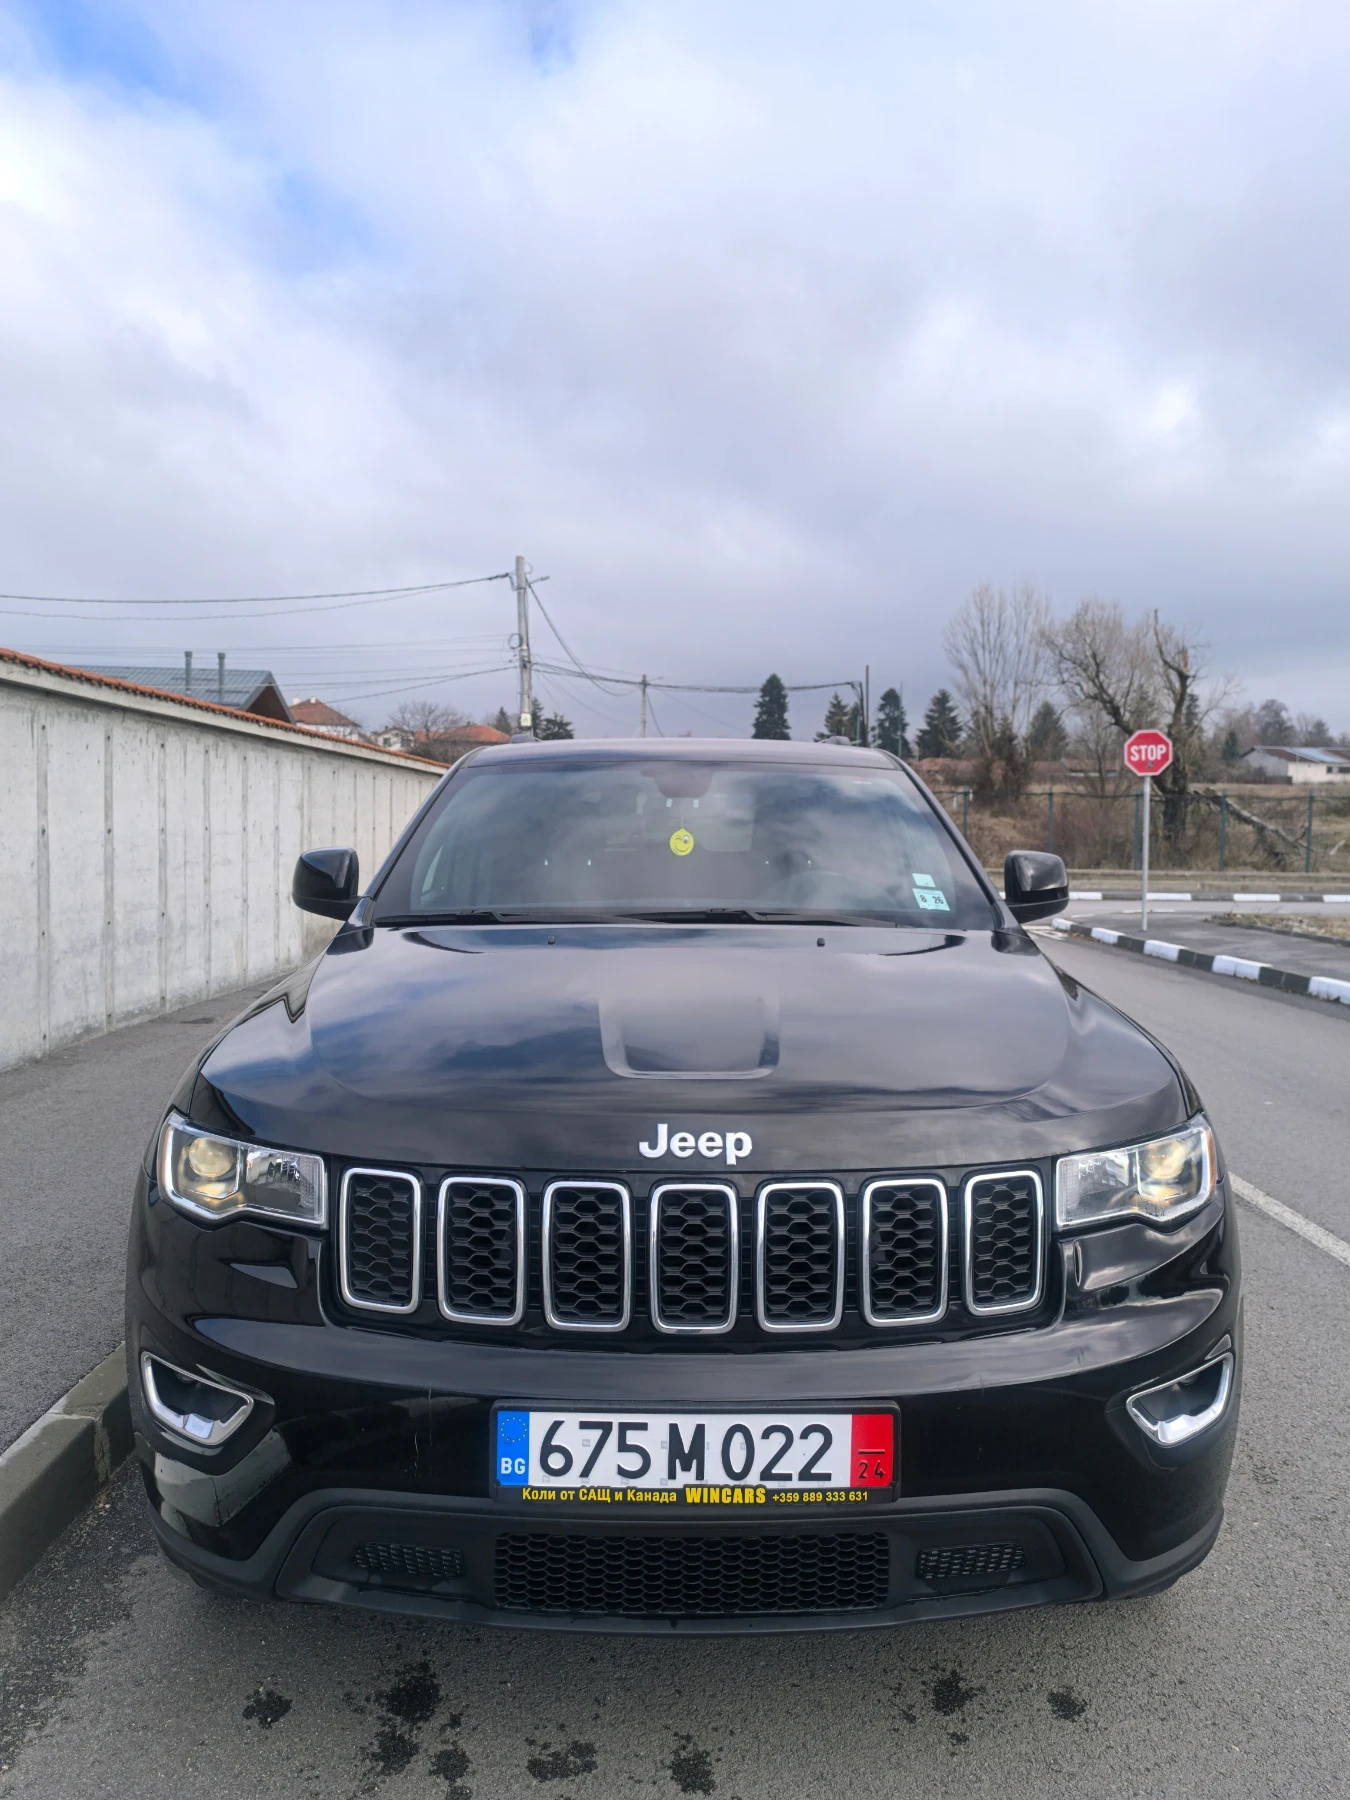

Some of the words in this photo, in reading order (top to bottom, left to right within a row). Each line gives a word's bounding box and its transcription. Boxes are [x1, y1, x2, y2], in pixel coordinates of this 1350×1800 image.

[1130, 744, 1167, 761] STOP
[638, 1123, 753, 1165] Jeep
[539, 1420, 651, 1479] 675
[667, 1423, 706, 1480] M
[721, 1423, 833, 1482] 022
[500, 1457, 526, 1475] BG
[858, 1460, 885, 1479] 24
[522, 1487, 556, 1500] Коли
[560, 1490, 576, 1500] от
[578, 1488, 611, 1503] САЩ
[614, 1491, 623, 1501] и
[627, 1489, 677, 1503] Канада
[685, 1487, 766, 1504] WINCARS
[772, 1492, 800, 1503] +359
[802, 1492, 823, 1502] 889
[825, 1491, 846, 1502] 333
[848, 1491, 868, 1501] 631
